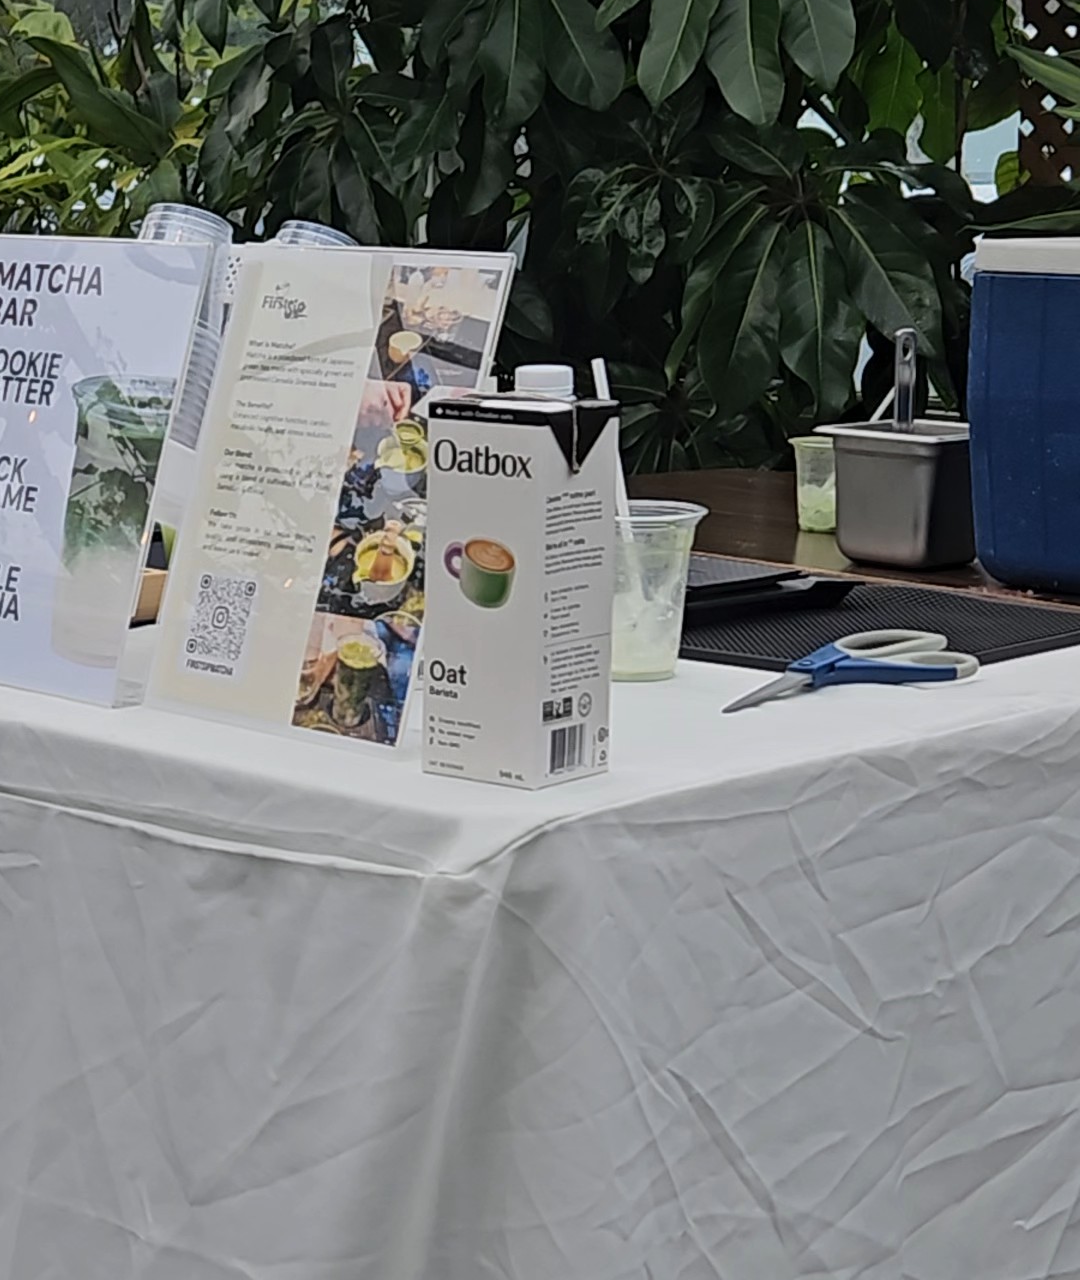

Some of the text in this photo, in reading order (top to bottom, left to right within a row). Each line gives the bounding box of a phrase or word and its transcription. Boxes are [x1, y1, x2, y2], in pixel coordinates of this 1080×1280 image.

[434, 439, 533, 480] Oatbox
[429, 660, 467, 686] Oat
[429, 685, 458, 699] Barista
